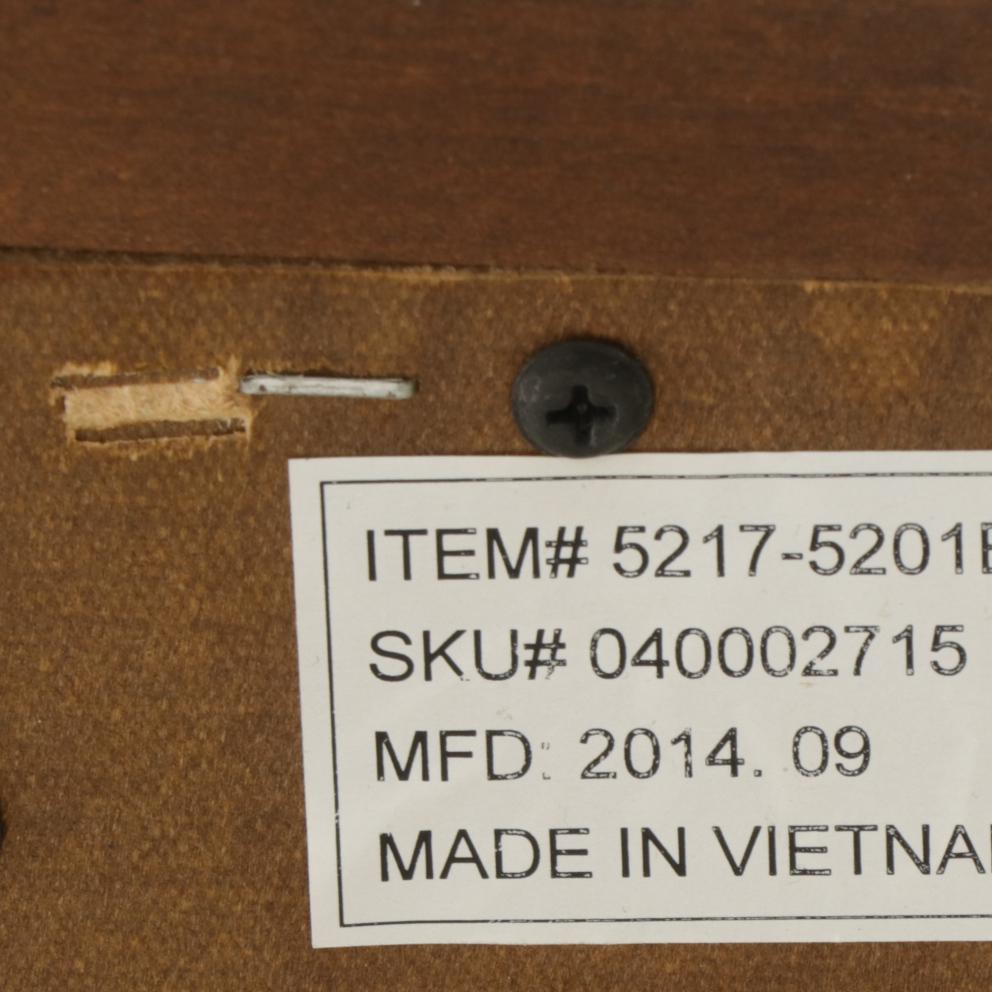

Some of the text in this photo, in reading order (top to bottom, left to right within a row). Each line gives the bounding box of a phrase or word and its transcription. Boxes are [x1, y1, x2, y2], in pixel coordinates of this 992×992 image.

[366, 526, 590, 582] ITEM#
[368, 624, 968, 682] SKU# 040002715
[791, 726, 871, 777] 09
[379, 828, 592, 883] MADE
[620, 826, 687, 878] IN
